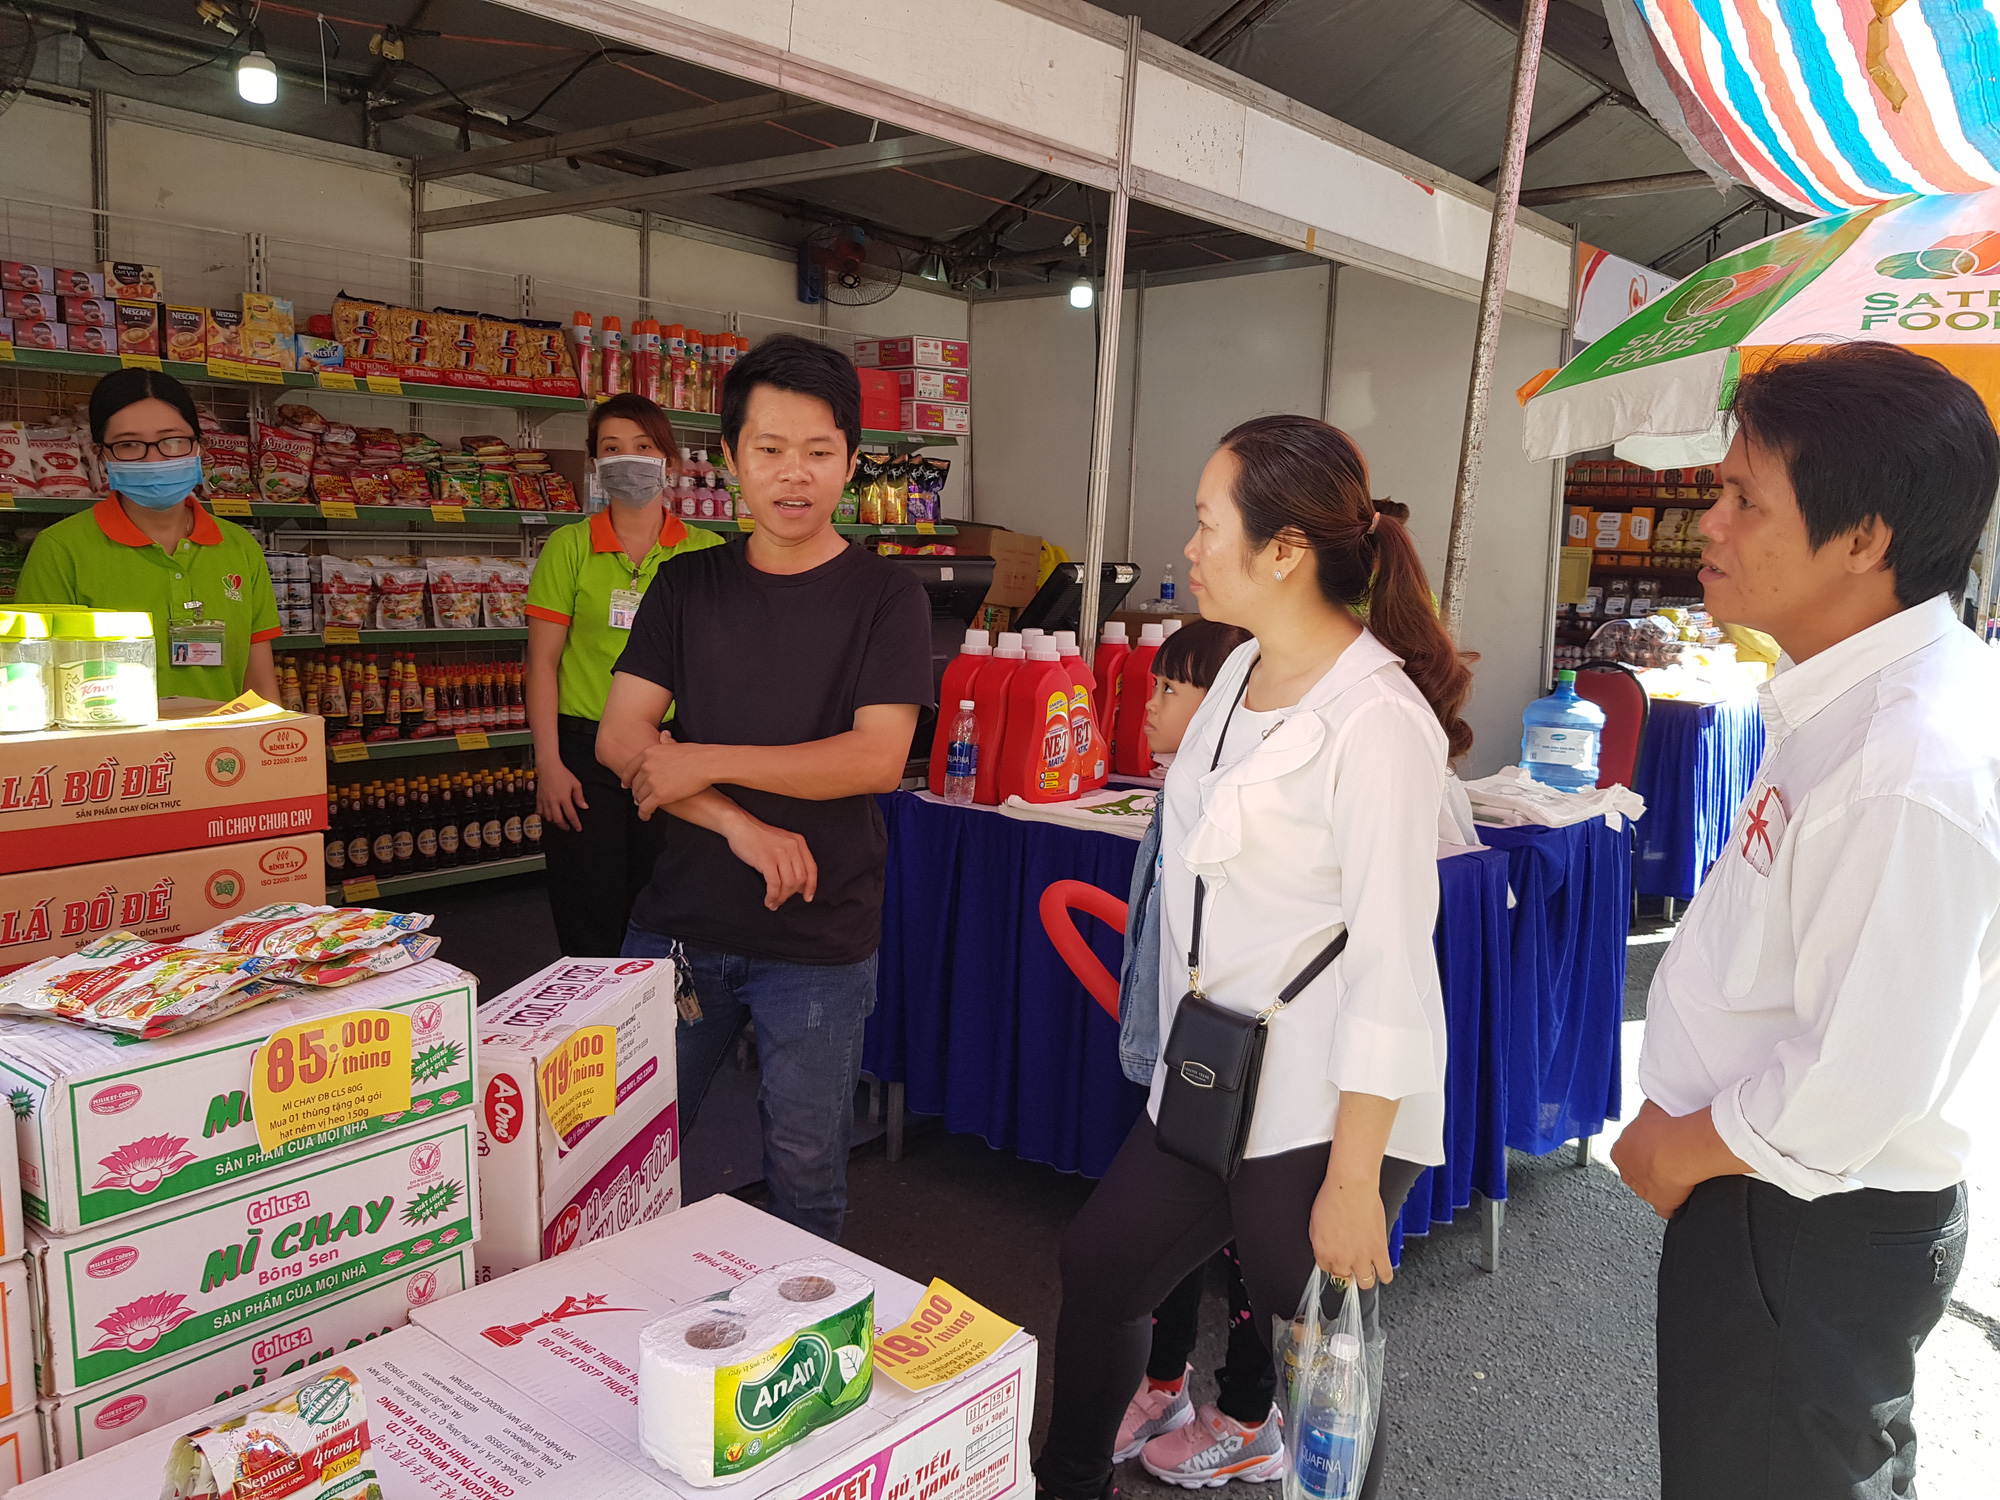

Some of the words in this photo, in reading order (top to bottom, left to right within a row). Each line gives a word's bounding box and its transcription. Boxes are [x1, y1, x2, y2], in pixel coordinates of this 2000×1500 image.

[1618, 315, 1730, 352] SATRA
[1593, 333, 1706, 373] FOODS
[1043, 732, 1068, 760] NET
[1078, 744, 1088, 754] ATIC
[948, 755, 970, 764] QUAFINA
[1048, 755, 1065, 768] MATIC
[0, 765, 57, 813] LÁ
[61, 757, 120, 807] BỒ
[121, 751, 176, 800] ĐỀ
[76, 808, 92, 818] SẢN
[119, 804, 139, 814] CHAY
[140, 801, 159, 811] ĐÍCH
[161, 800, 181, 809] THỰC
[208, 815, 224, 838] MÌ
[226, 815, 256, 836] CHAY
[259, 811, 288, 832] CHUA
[290, 808, 312, 827] CAY
[0, 896, 55, 947] LÁ
[60, 886, 118, 938] BỒ
[120, 876, 175, 927] ĐỀ
[140, 928, 158, 937] ĐÍCH
[282, 1100, 292, 1112] MÌ
[294, 1096, 317, 1108] CHAY
[318, 1092, 330, 1102] ĐB
[332, 1087, 346, 1098] CLS
[348, 1083, 363, 1094] 80G
[270, 1119, 287, 1130] Mua
[288, 1113, 299, 1124] 01
[302, 1105, 330, 1120] thùng
[332, 1101, 352, 1112] tặng
[354, 1094, 366, 1105] 04
[366, 1091, 382, 1104] gói
[280, 1128, 294, 1140] hạt
[295, 1122, 316, 1135] nêm
[318, 1119, 327, 1130] vị
[328, 1114, 346, 1126] heo
[348, 1107, 370, 1120] 150g
[617, 1170, 640, 1231] CHI
[641, 1127, 672, 1194] TÔM
[248, 1192, 310, 1224] Colusa
[200, 1228, 263, 1294] MÌ
[271, 1196, 394, 1260] CHAY
[308, 1249, 339, 1268] Sen
[717, 1250, 756, 1270] SYSTEM
[718, 1264, 746, 1280] THỰC
[214, 1309, 241, 1329] SẢN
[245, 1290, 282, 1318] PHẨM
[286, 1282, 312, 1302] CỦA
[316, 1274, 339, 1292] MỌI
[342, 1262, 367, 1277] NHÀ
[924, 1310, 976, 1349] /thùng
[252, 1327, 312, 1364] Colusa
[569, 1338, 596, 1354] VÀNG
[537, 1338, 555, 1347] DO
[550, 1346, 572, 1358] CỤC
[567, 1356, 604, 1377] ATVSTP
[600, 1376, 634, 1397] THUỘC
[965, 1357, 976, 1365] AN
[976, 1350, 987, 1358] AN
[366, 1366, 381, 1378] NAM
[378, 1374, 392, 1386] VIỆT
[448, 1374, 475, 1393] VIETNAM
[472, 1389, 482, 1397] OF
[752, 1357, 816, 1417] AnAn
[376, 1396, 407, 1416] WONG
[479, 1395, 508, 1415] PRODUCT
[992, 1392, 1001, 1401] 15
[316, 1429, 330, 1443] HẠT
[331, 1419, 350, 1436] NÊM
[403, 1416, 419, 1427] VE
[520, 1422, 535, 1434] VIỆT
[972, 1425, 984, 1436] 65g
[991, 1406, 1008, 1424] 30gói
[414, 1424, 451, 1450] SAIGON
[533, 1431, 547, 1442] CỦA
[419, 1447, 450, 1469] WONG
[449, 1449, 475, 1469] TNHH
[563, 1451, 577, 1462] SẢN
[1302, 1445, 1342, 1476] QUAFINA
[238, 1460, 297, 1495] Neptune
[331, 1462, 343, 1476] Vị
[446, 1467, 463, 1480] VE
[469, 1468, 483, 1478] TY
[532, 1467, 546, 1478] TEL:
[888, 1474, 910, 1499] HỦ
[915, 1448, 952, 1486] TIẾU
[484, 1475, 515, 1497] CÔNG
